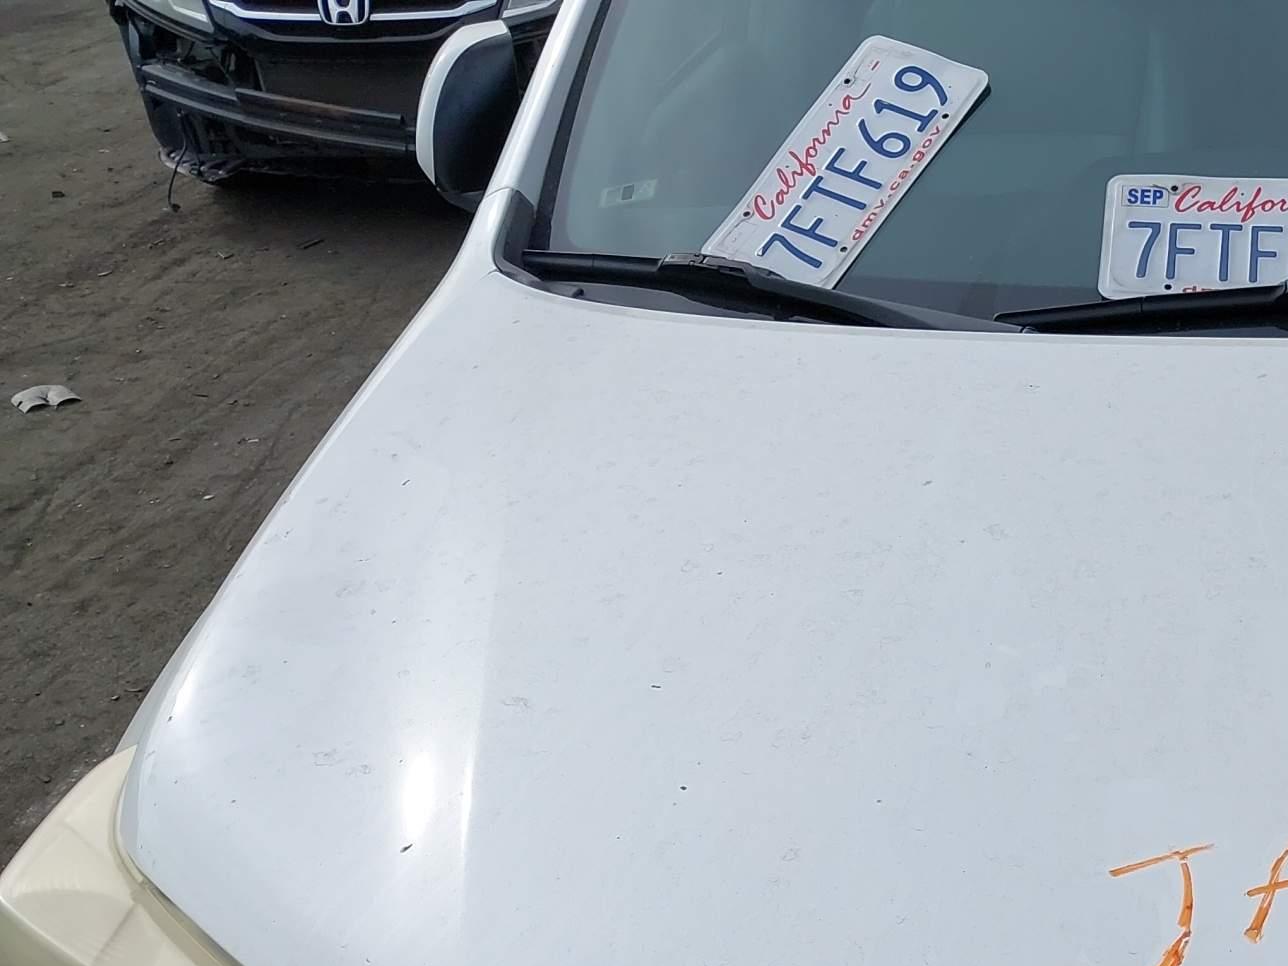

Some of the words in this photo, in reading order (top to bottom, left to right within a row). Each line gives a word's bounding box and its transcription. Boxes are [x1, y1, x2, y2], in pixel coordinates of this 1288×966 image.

[753, 82, 872, 220] California
[755, 65, 949, 269] 7FTF619
[852, 126, 941, 241] dmv.ca.gov
[1127, 187, 1164, 206] SEP
